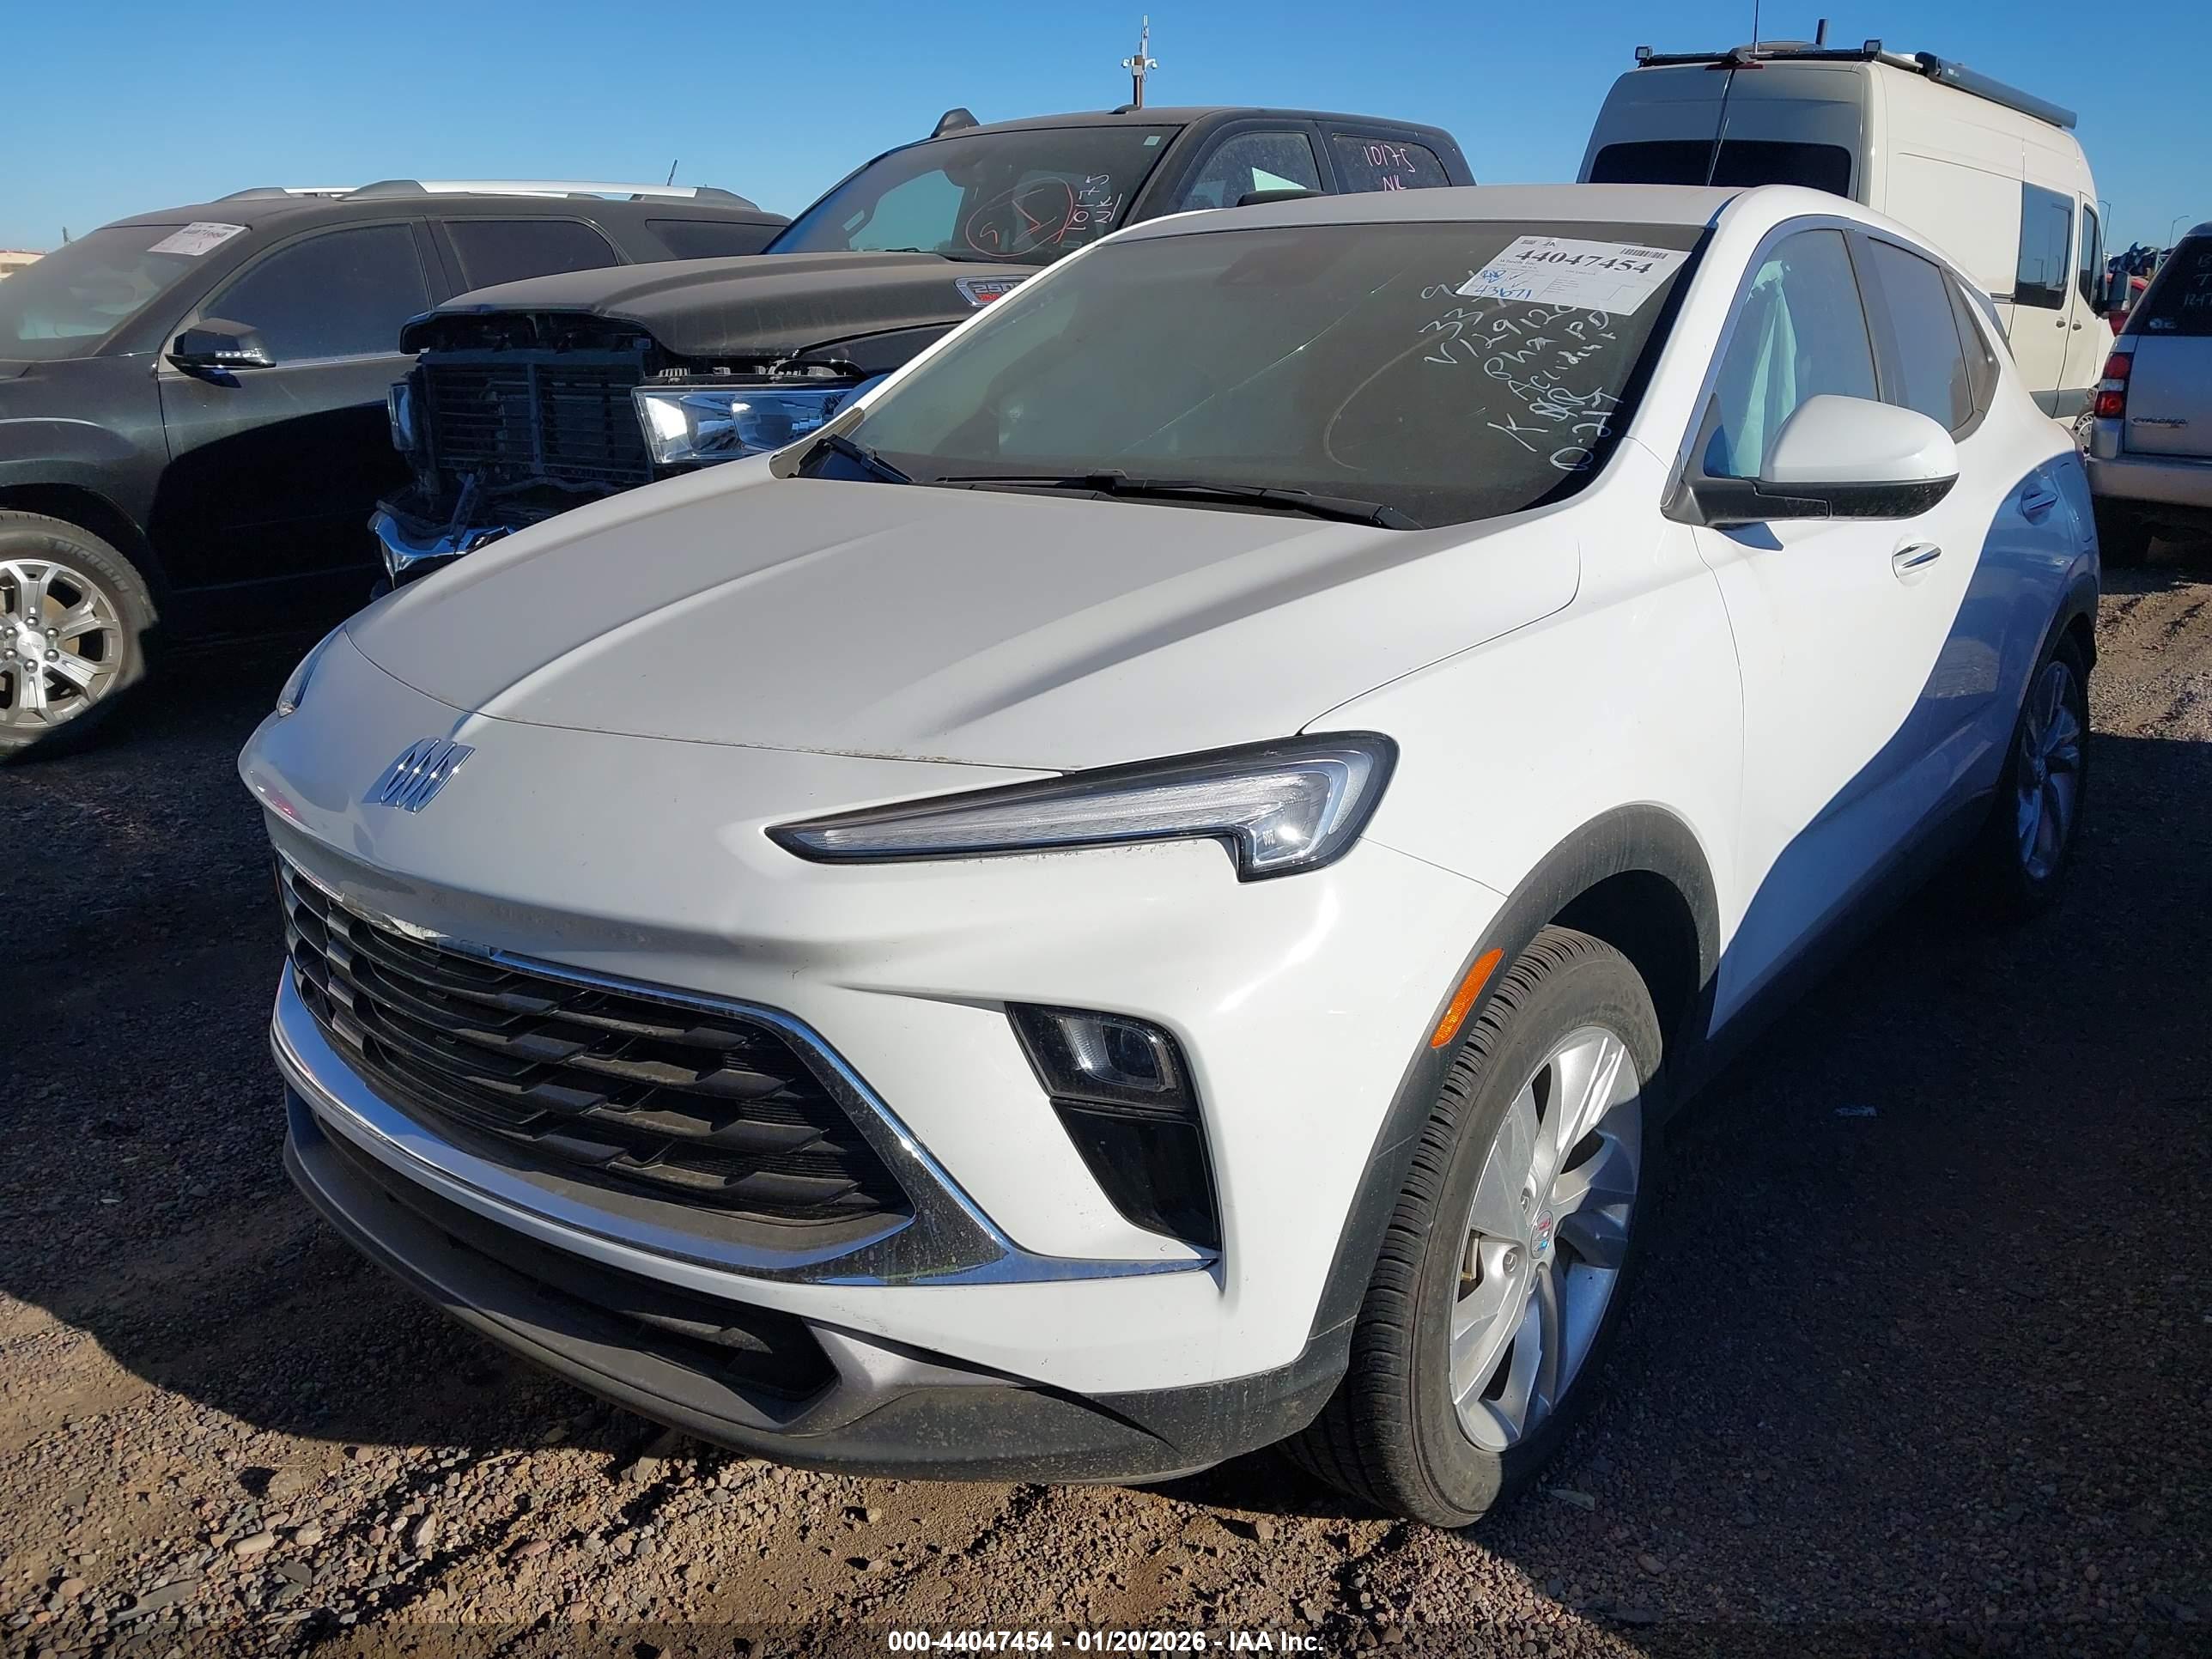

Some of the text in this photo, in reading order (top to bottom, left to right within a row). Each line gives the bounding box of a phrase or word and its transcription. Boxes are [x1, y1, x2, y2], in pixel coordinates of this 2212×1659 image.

[1362, 143, 1417, 173] 10175
[1515, 249, 1654, 274] 44047454
[972, 281, 1021, 295] 250
[1474, 283, 1533, 300] 43671
[54, 540, 130, 592] MICHELIN
